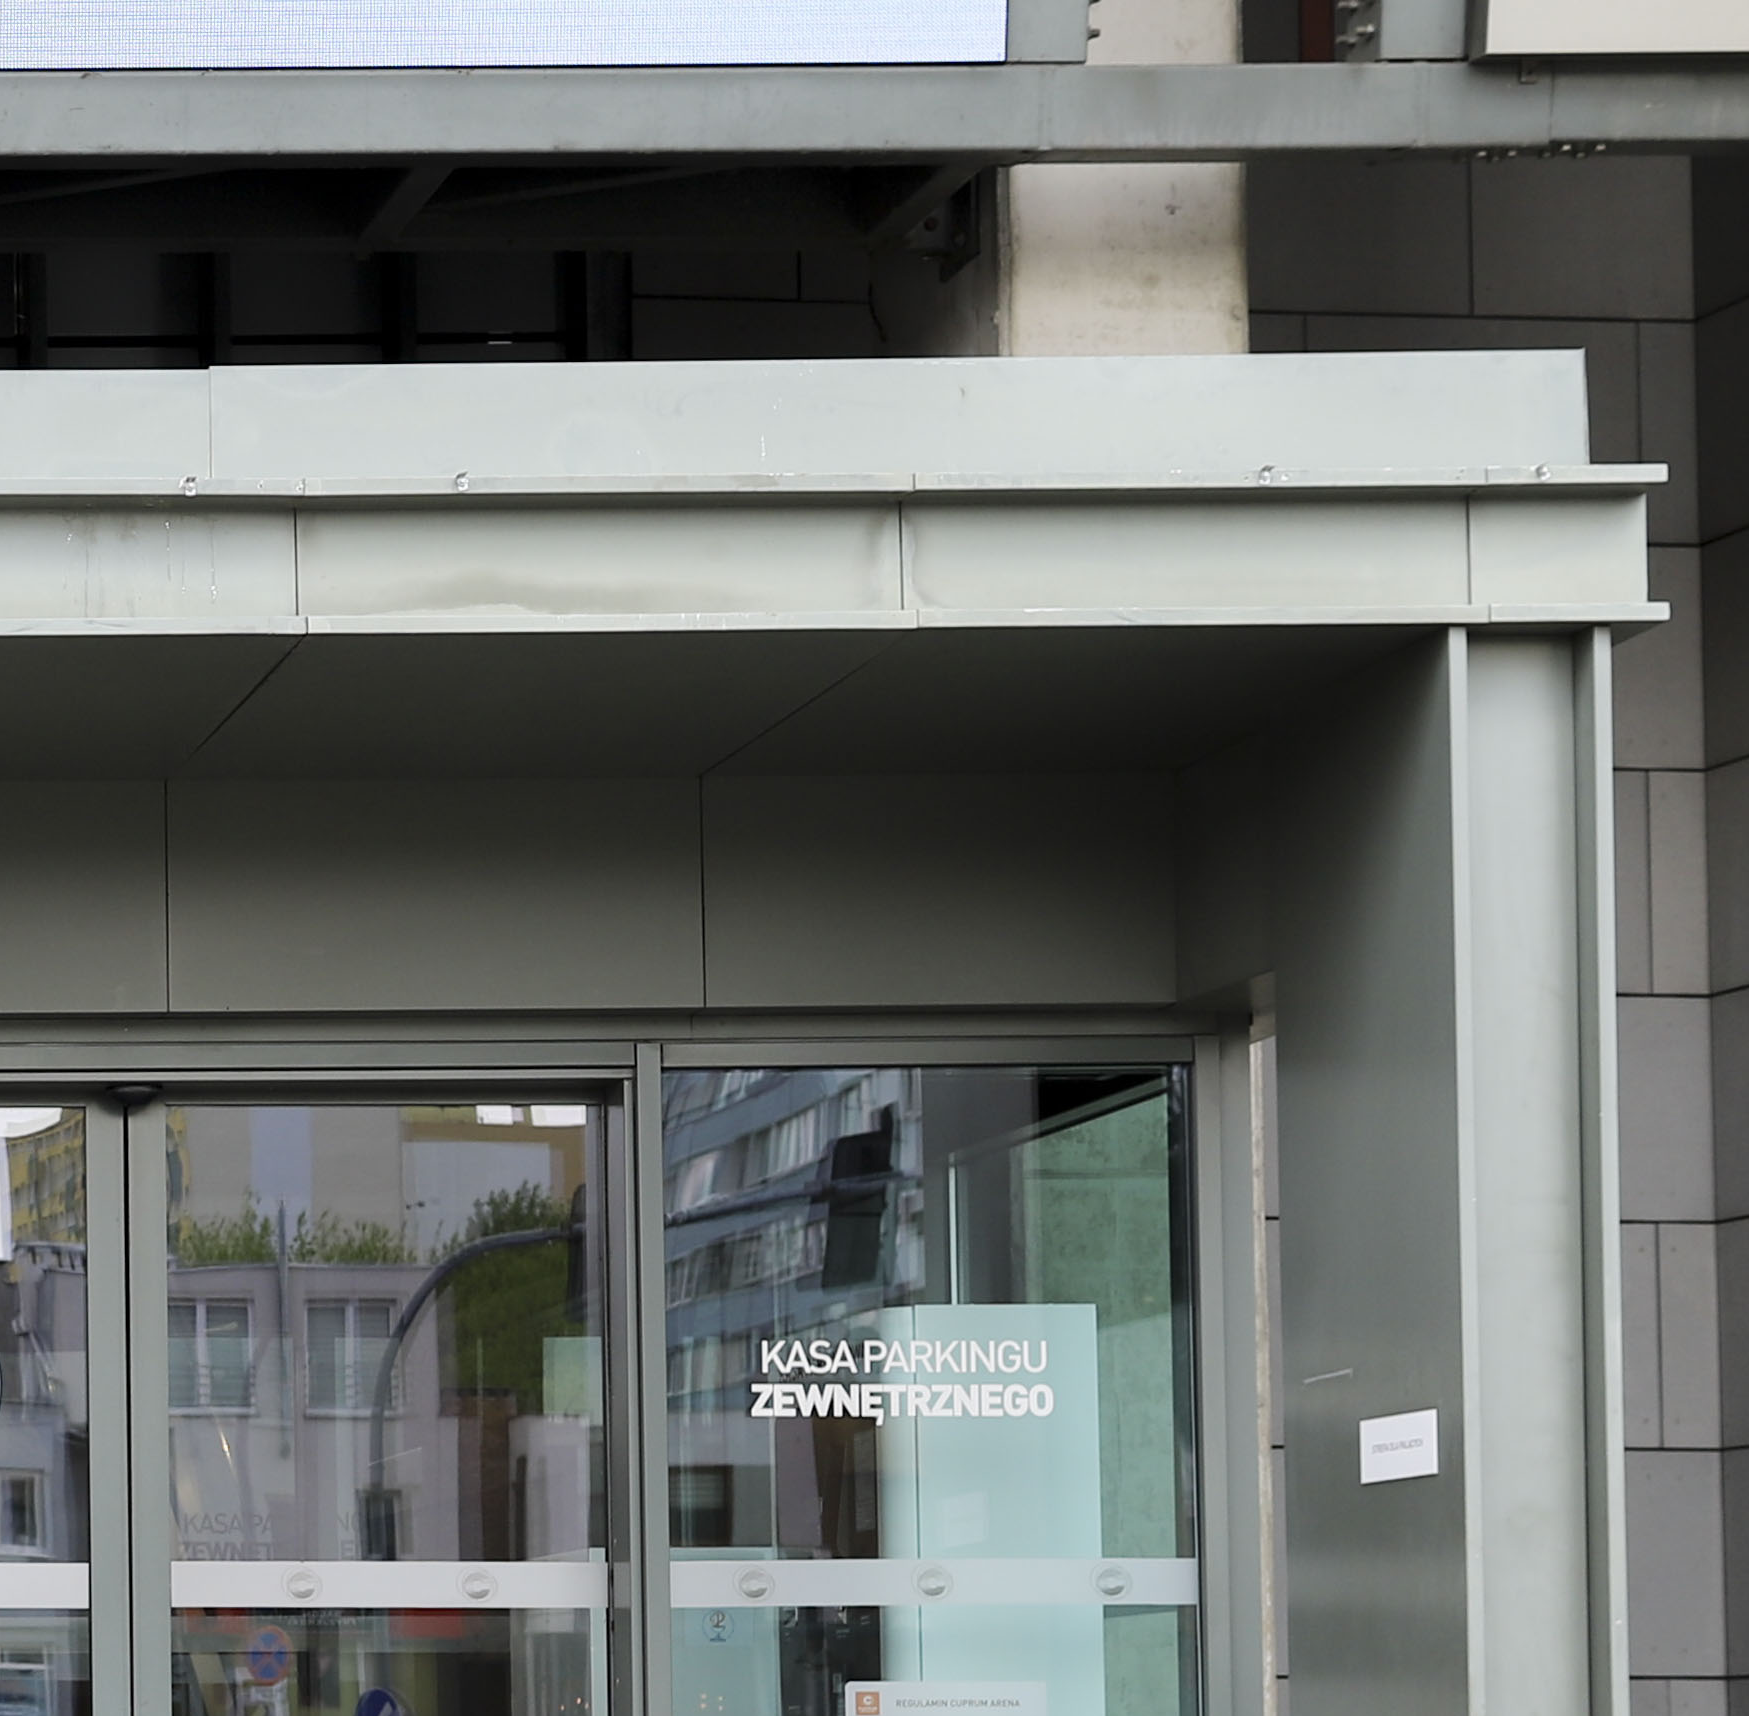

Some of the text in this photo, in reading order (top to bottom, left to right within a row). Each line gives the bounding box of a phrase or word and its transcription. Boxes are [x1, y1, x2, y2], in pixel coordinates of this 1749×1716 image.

[760, 1340, 1049, 1374] KASA PARKINGU
[750, 1384, 1055, 1426] ZEWNĘTRZNEGO
[895, 1699, 1020, 1708] REGULAMIN CUPRUM ARENA
